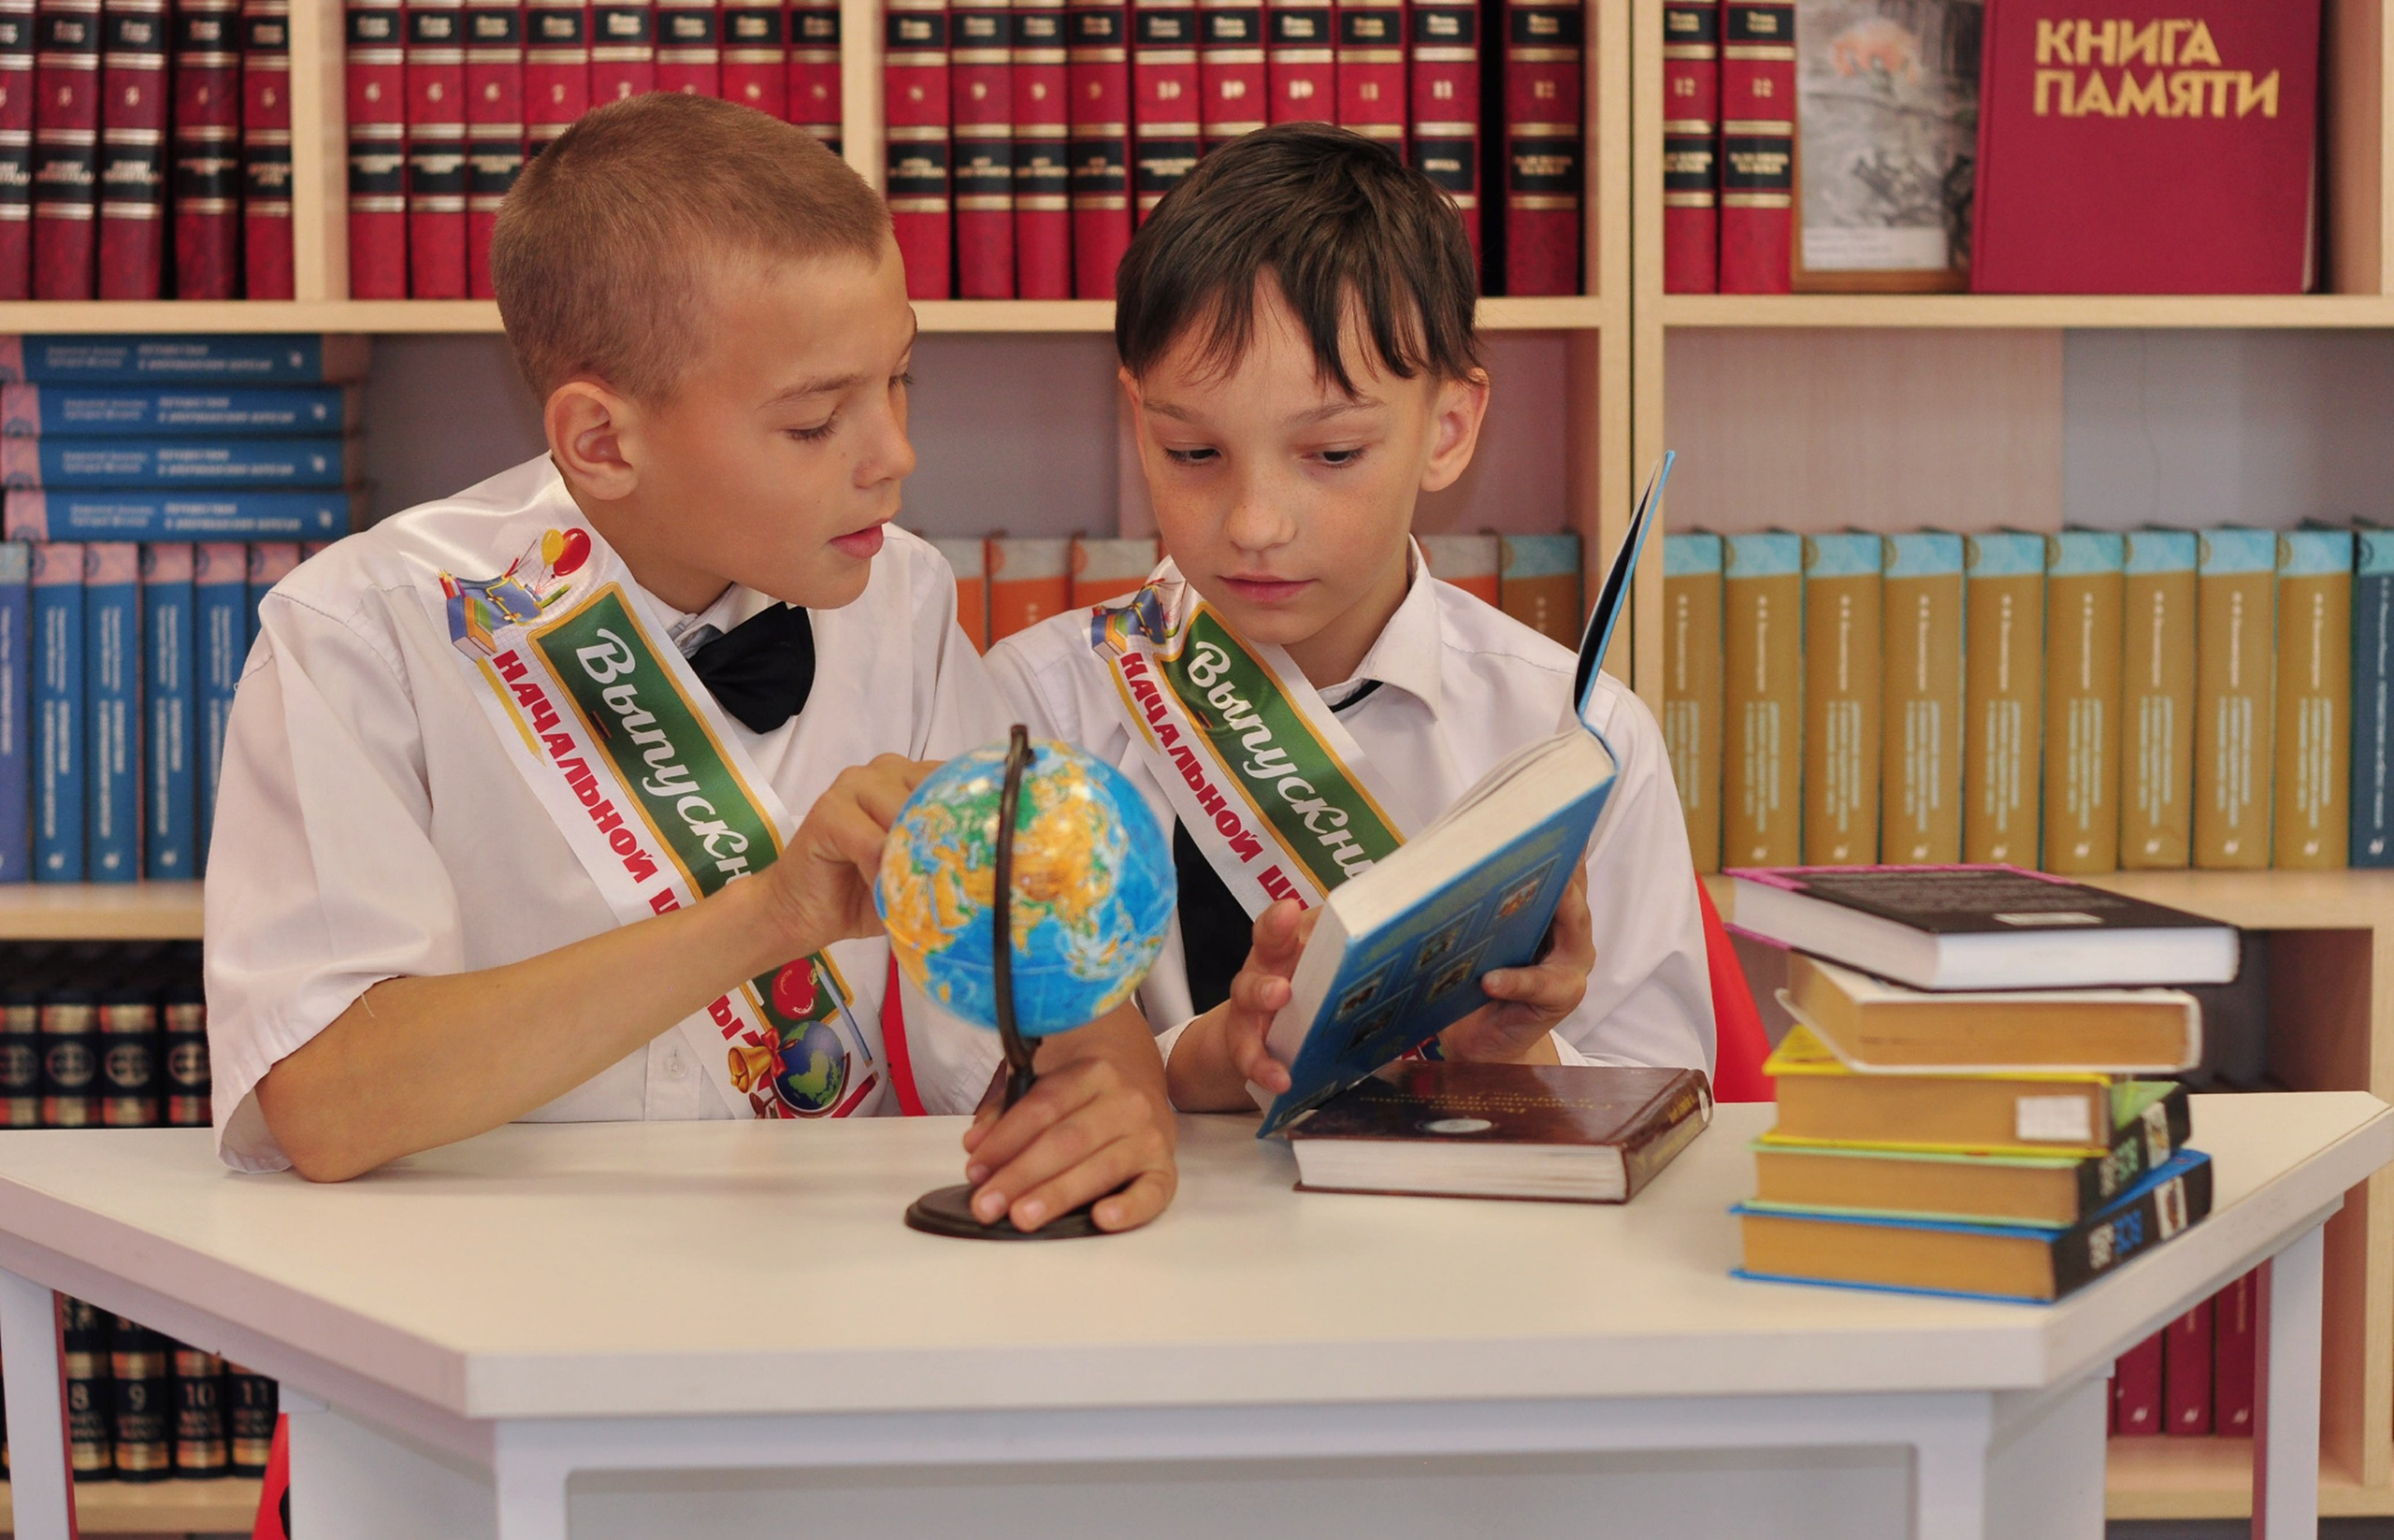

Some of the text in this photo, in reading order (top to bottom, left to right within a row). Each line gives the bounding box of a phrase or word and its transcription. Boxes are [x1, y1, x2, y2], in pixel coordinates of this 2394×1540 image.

[2035, 19, 2222, 66] КНИГА
[2033, 68, 2280, 118] ПАМЯТИ
[492, 649, 658, 884] НАЧАЛЬНОЙ
[575, 627, 752, 885] Выпускн
[1120, 652, 1264, 864] НАЧАЛЬНОЙ
[70, 1382, 90, 1411] 8
[128, 1382, 147, 1412] 9
[185, 1382, 216, 1407] 10
